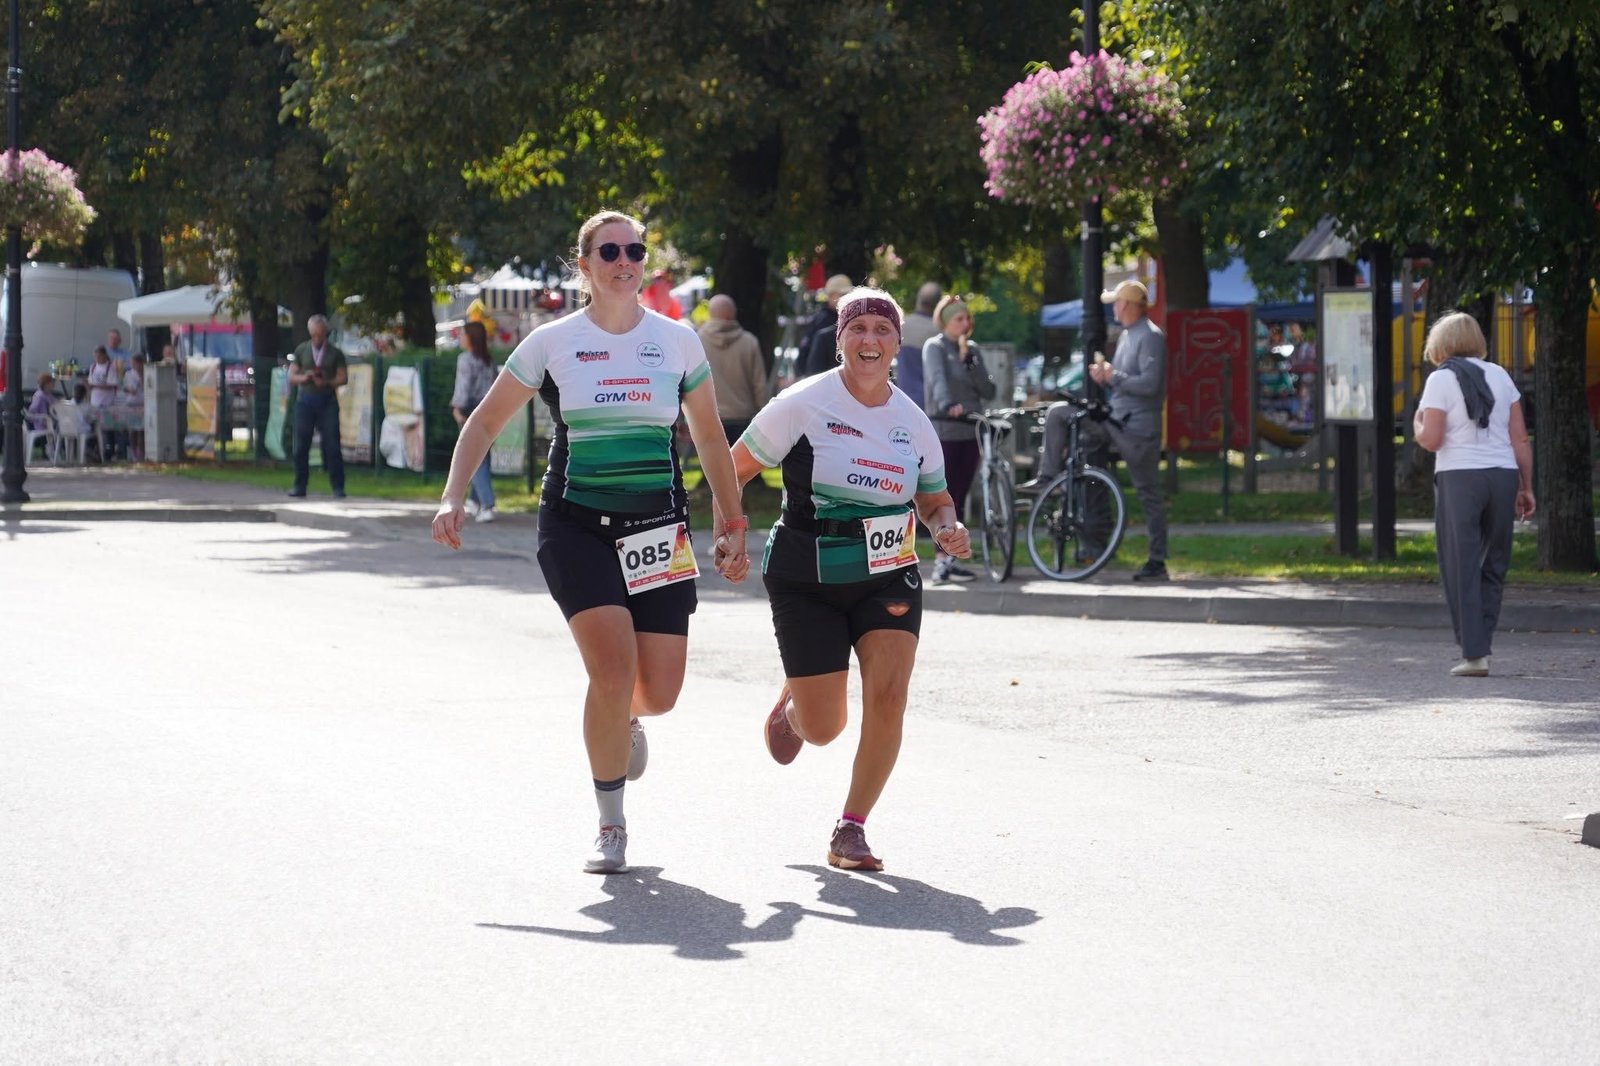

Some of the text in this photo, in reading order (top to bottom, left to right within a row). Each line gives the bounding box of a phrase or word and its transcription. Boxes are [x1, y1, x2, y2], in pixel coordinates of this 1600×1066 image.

[595, 391, 651, 403] GYMON
[847, 473, 903, 494] GYMON
[871, 527, 904, 550] 084
[626, 541, 671, 570] 085
